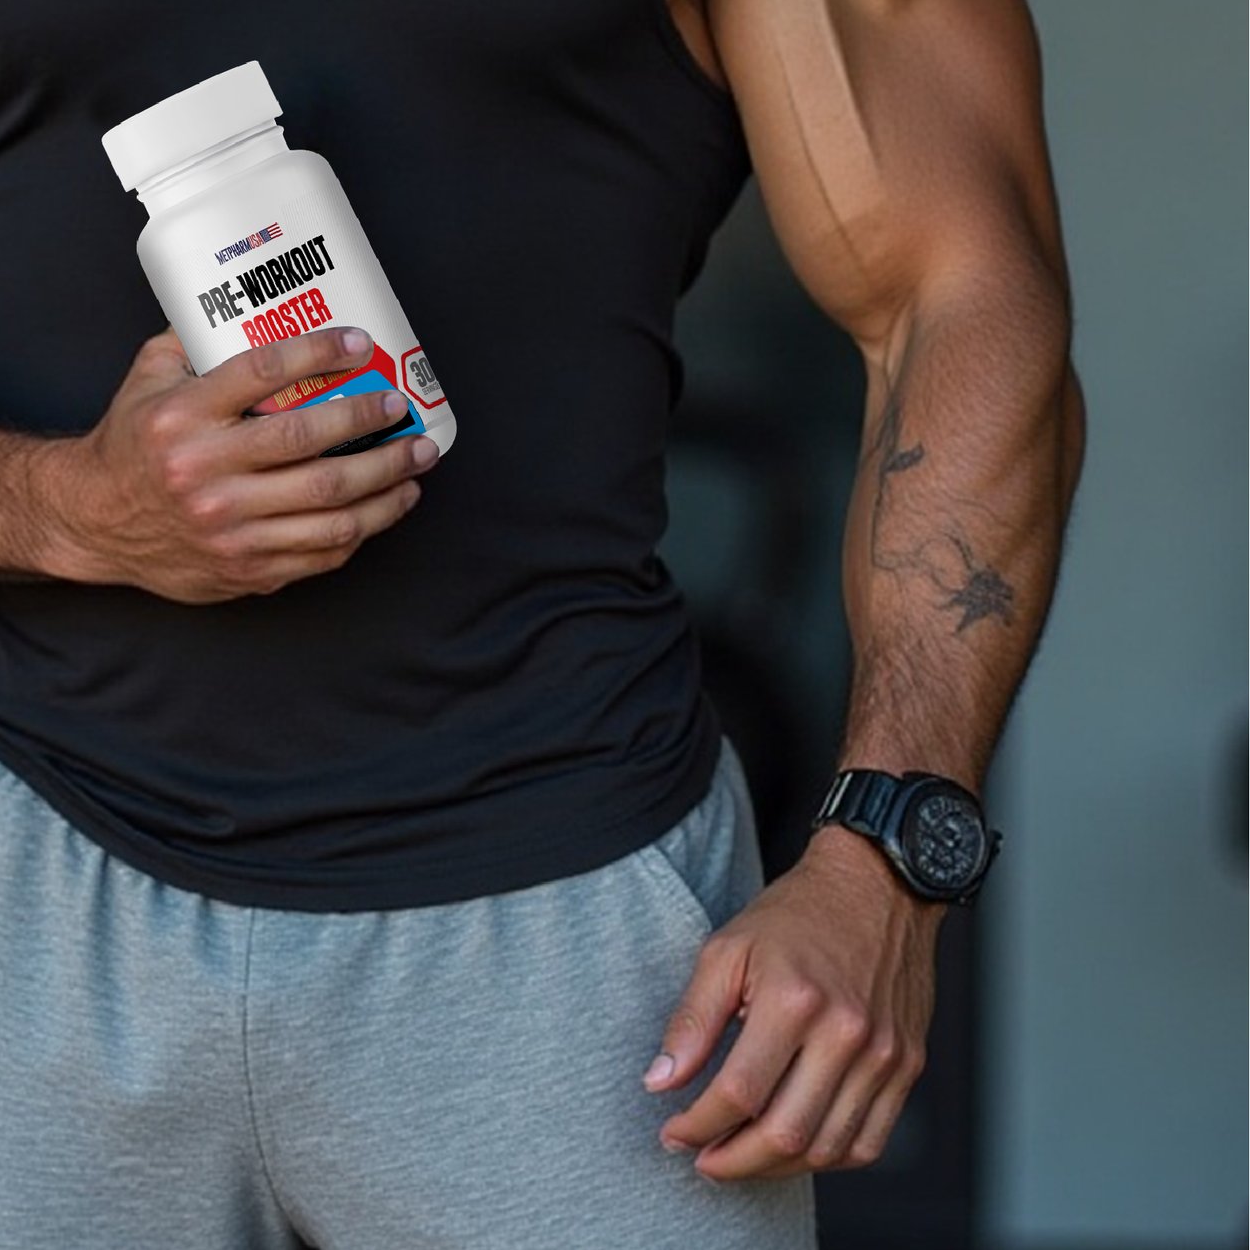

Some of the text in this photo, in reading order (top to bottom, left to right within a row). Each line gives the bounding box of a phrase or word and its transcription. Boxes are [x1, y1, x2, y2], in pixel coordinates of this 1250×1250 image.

[197, 234, 335, 329] PRE-WORKOUT
[241, 287, 334, 350] BOOSTER
[409, 356, 436, 388] 30
[273, 383, 303, 409] NITRIC
